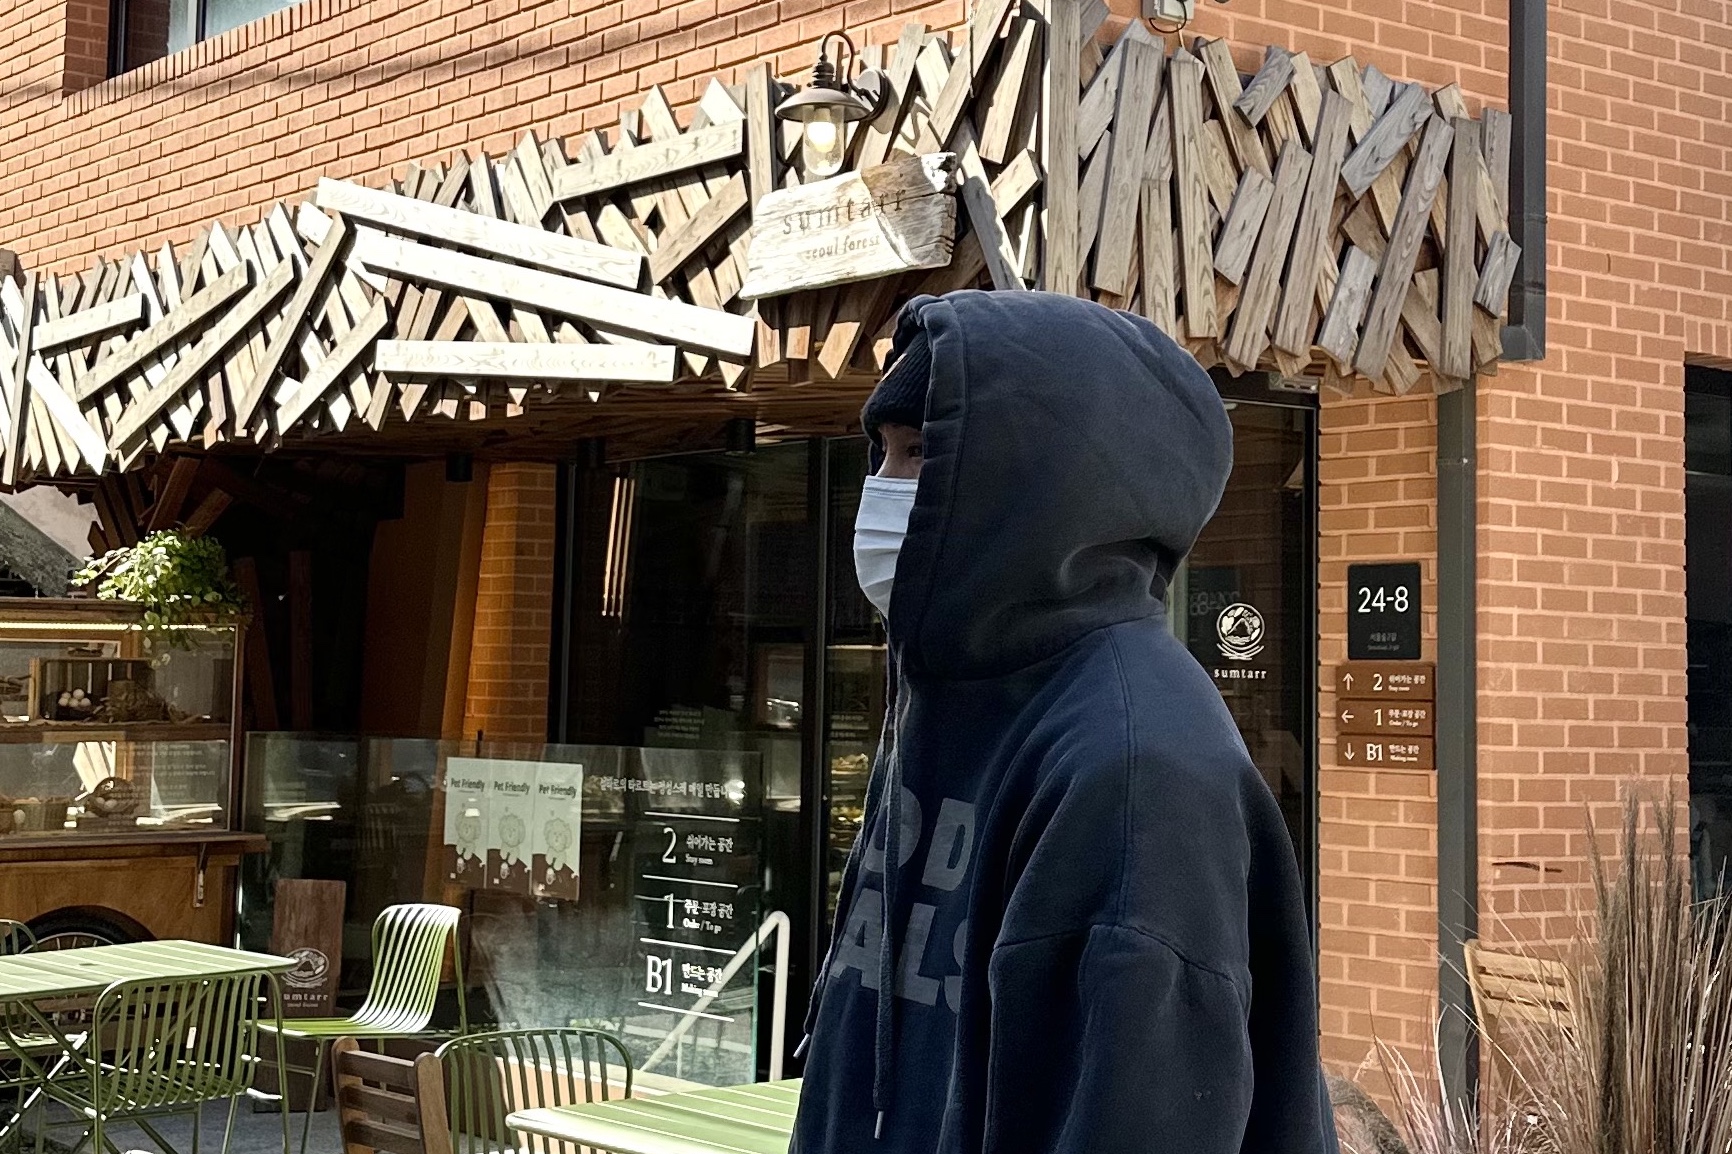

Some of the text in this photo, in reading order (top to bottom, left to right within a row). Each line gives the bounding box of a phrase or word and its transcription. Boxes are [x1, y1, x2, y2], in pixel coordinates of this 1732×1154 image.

[782, 189, 907, 236] sumtarr
[842, 233, 881, 256] forest
[1357, 585, 1409, 613] 24-8
[1213, 668, 1267, 679] sumtarr
[1372, 673, 1383, 691] 2
[1373, 708, 1382, 726] 1
[1365, 743, 1383, 761] B1
[450, 777, 486, 793] Pet Friendly
[493, 780, 531, 796] Pet Friendly
[538, 783, 578, 799] Pet Friendly
[704, 782, 735, 800] 만듭니
[661, 826, 677, 864] 2
[663, 892, 675, 929] 1
[645, 954, 673, 996] B1
[281, 993, 329, 1001] umtarr
